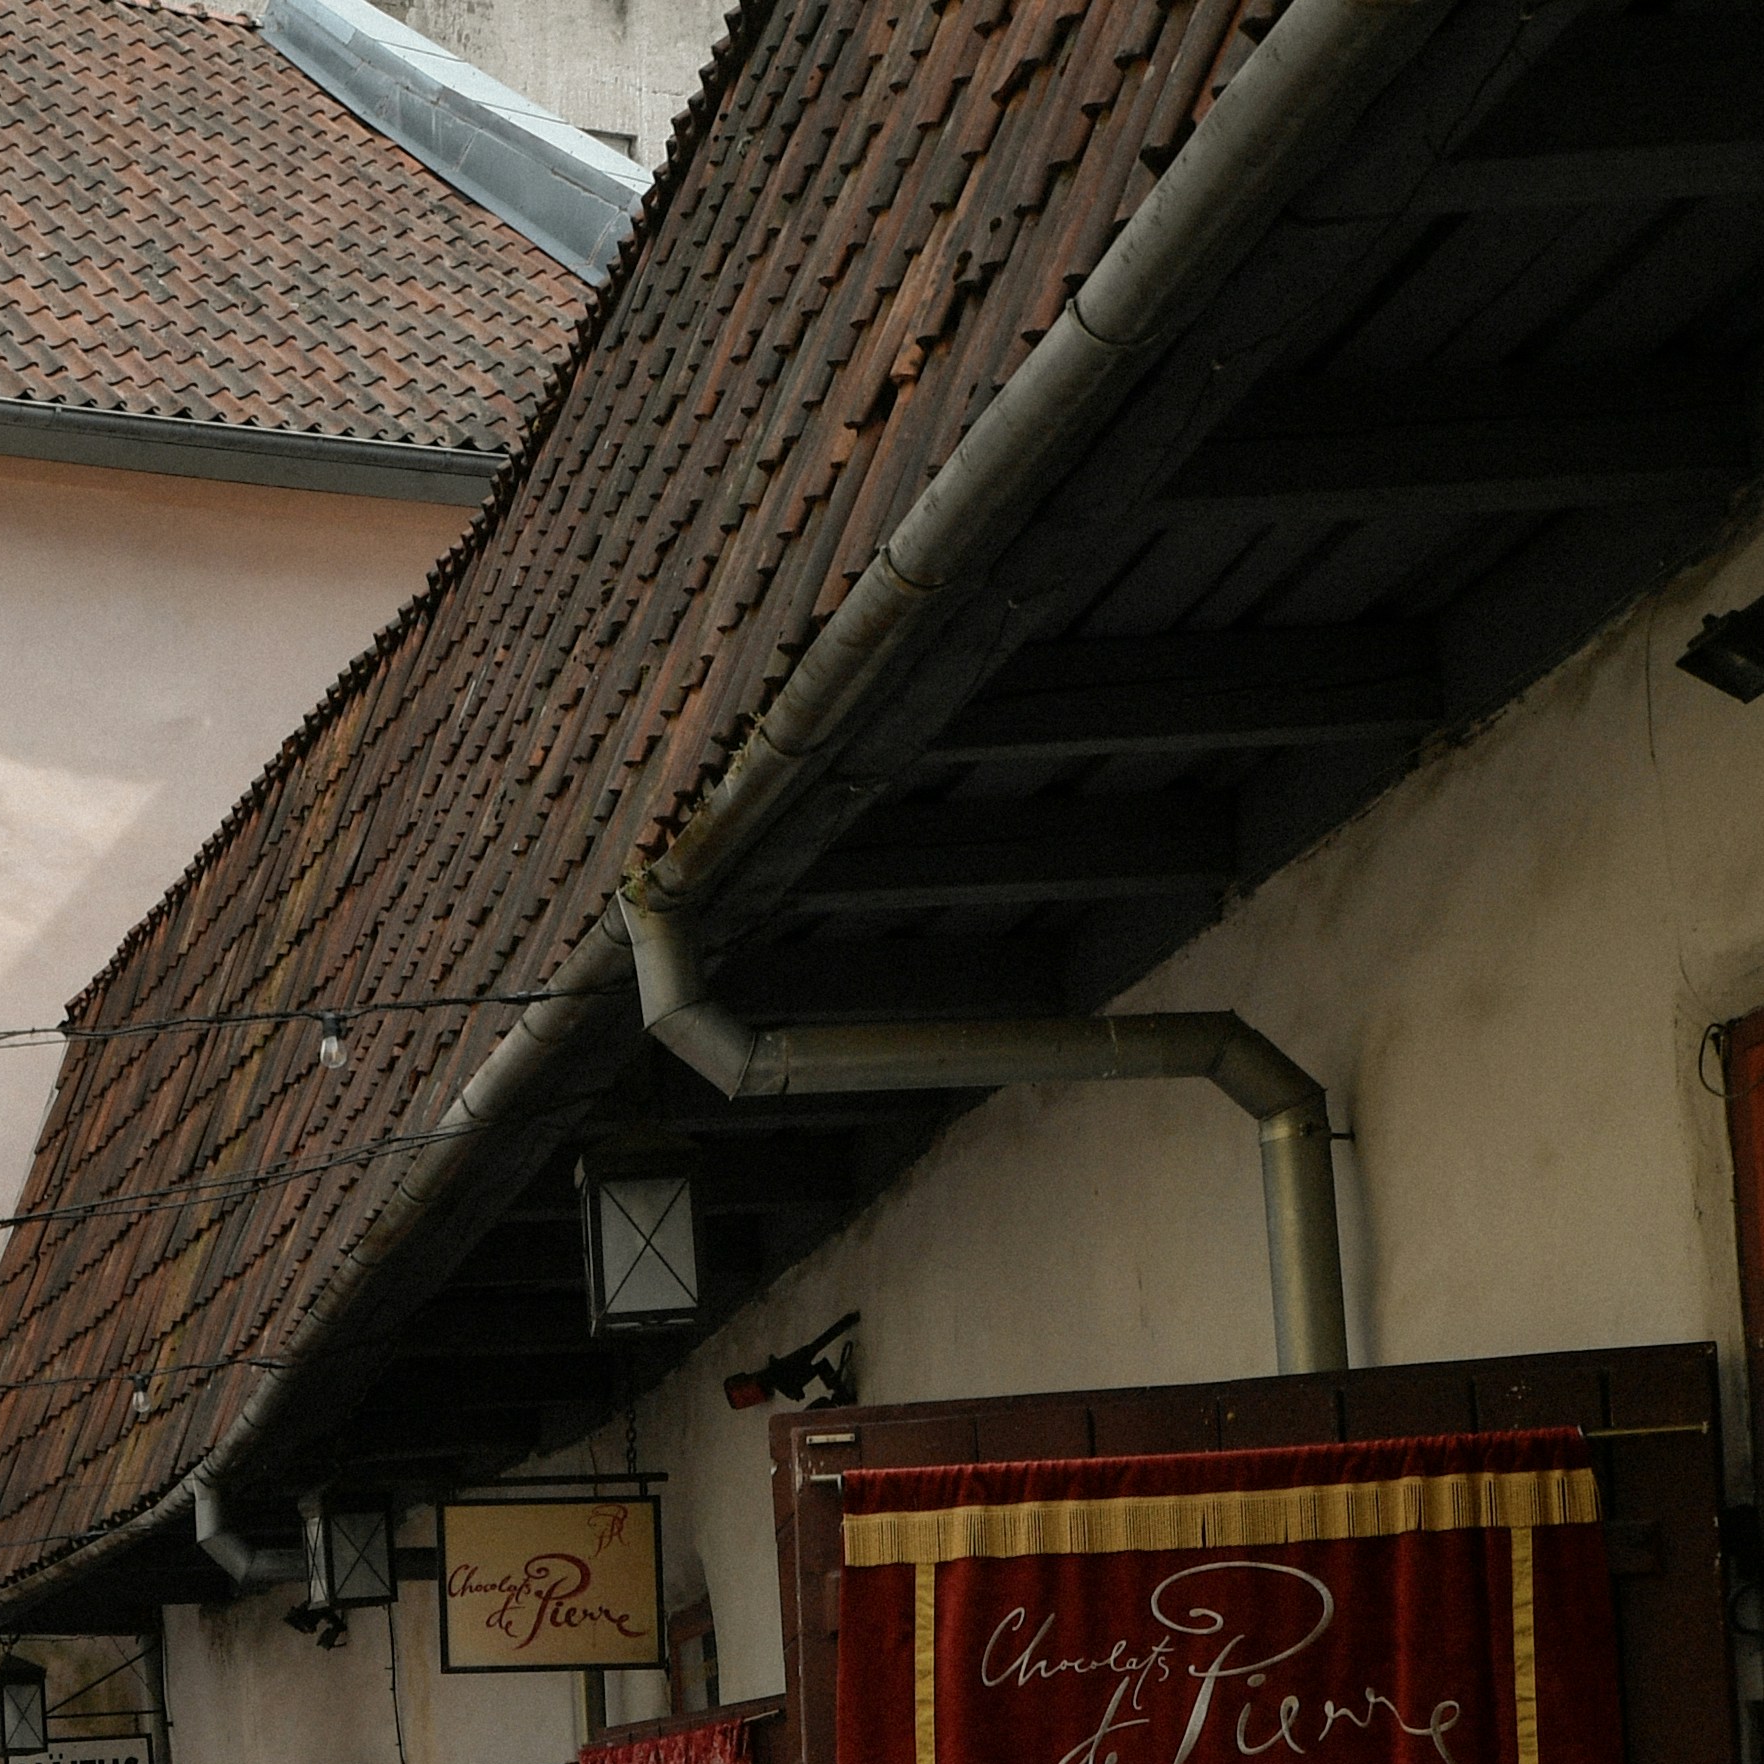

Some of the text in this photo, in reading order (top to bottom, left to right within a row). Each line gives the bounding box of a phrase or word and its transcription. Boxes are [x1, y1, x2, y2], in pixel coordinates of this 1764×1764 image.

[448, 1564, 531, 1604] Chocolats
[486, 1553, 648, 1649] de Pierre
[982, 1607, 1174, 1710] Chocolats
